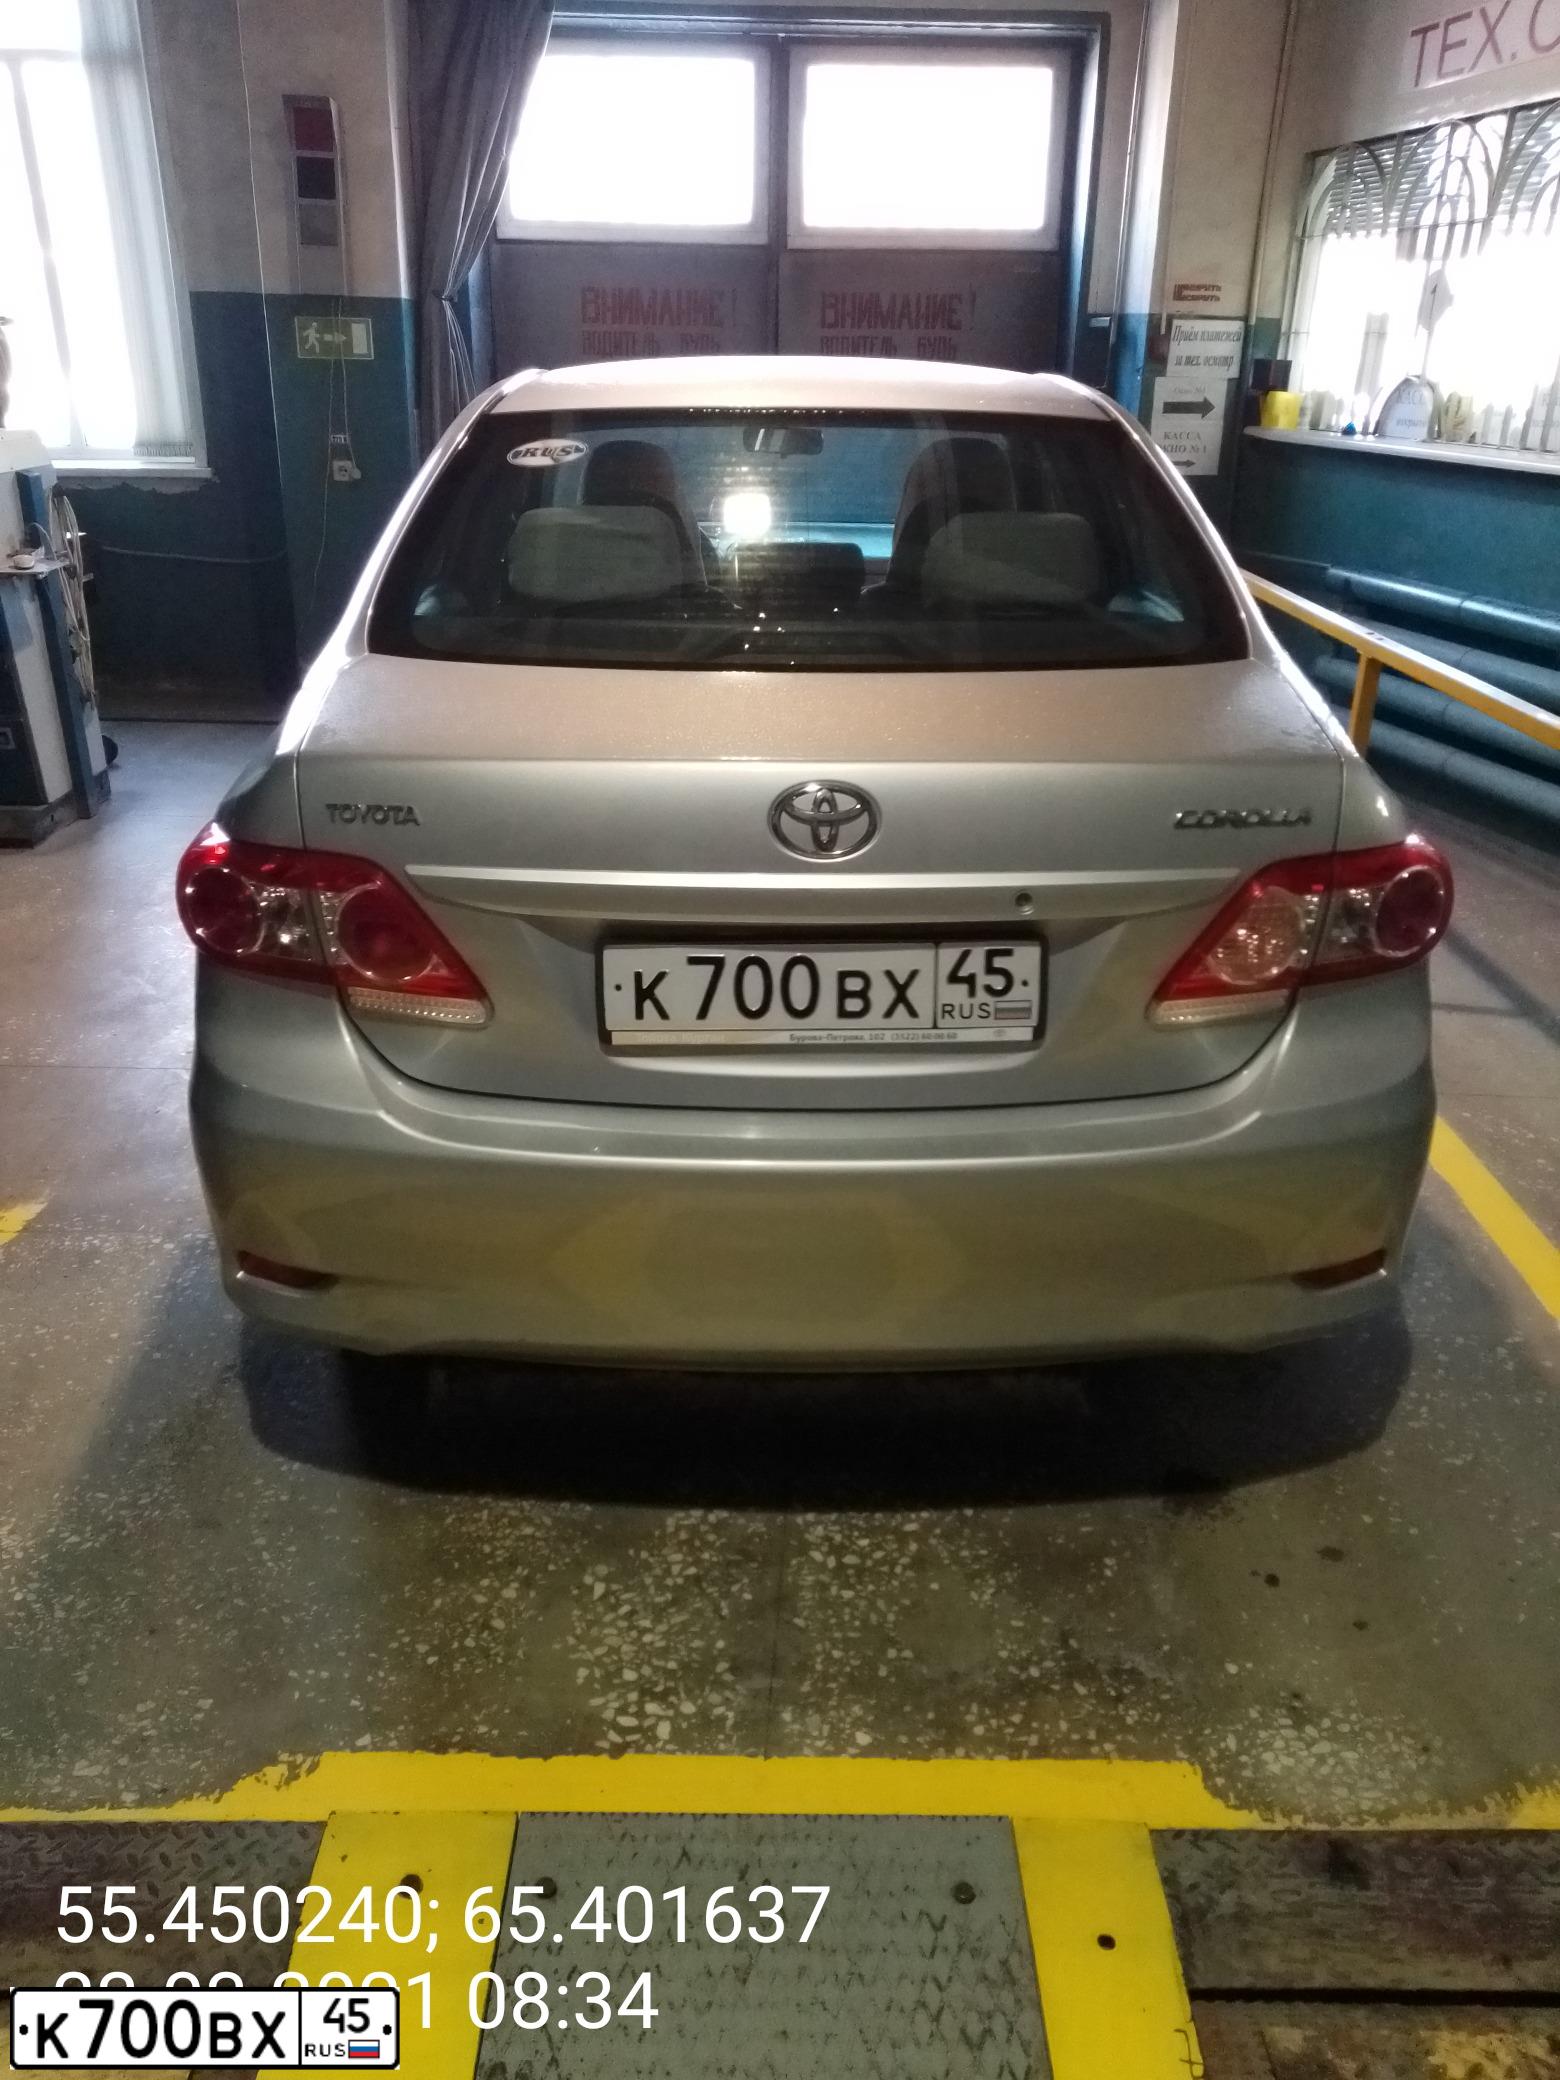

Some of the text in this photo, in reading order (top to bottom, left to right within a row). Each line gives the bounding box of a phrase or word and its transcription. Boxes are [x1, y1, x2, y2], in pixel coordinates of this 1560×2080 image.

[821, 282, 977, 330] ВНИМАНИЕ!
[1163, 431, 1202, 440] КАССА
[325, 803, 420, 826] TOYOTA
[1173, 808, 1312, 829] COROLLA
[947, 948, 1014, 998] 45
[941, 1003, 991, 1019] RUS
